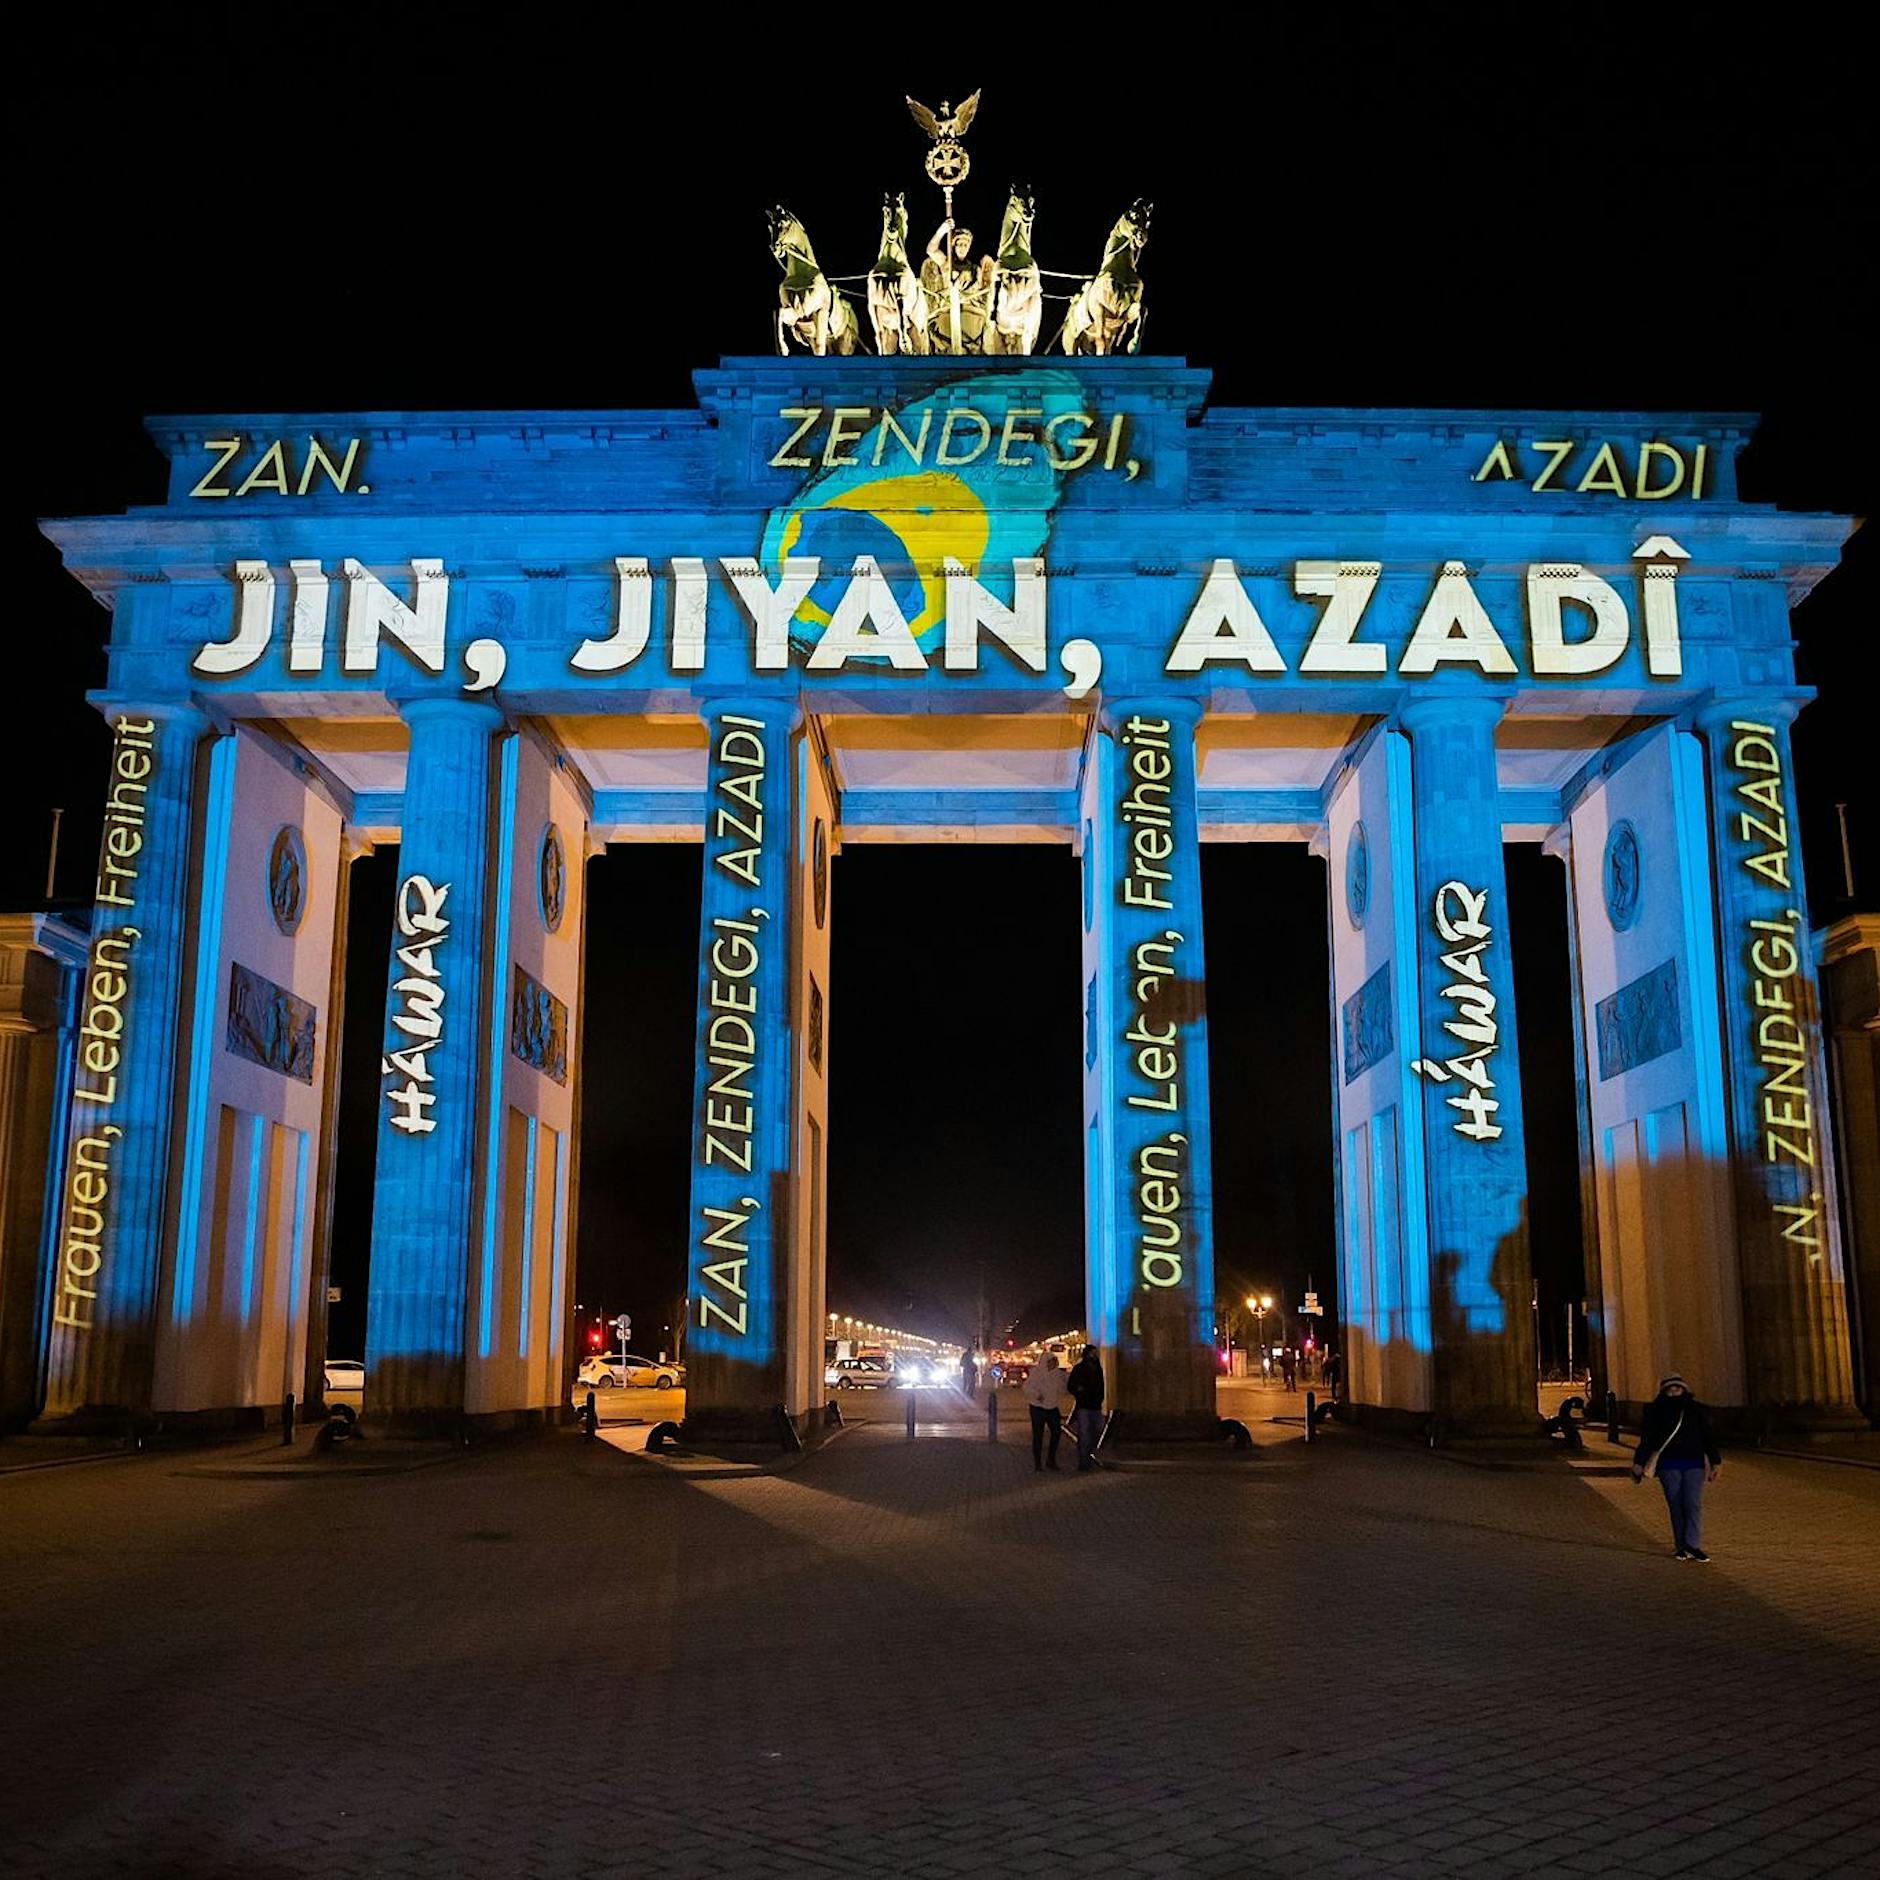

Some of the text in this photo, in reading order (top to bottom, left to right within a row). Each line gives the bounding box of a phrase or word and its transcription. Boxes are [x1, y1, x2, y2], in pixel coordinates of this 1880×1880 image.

[767, 406, 1141, 482] ZENDEGI,
[1470, 440, 1708, 500] AZADI
[193, 535, 1692, 700] JIN, JIYAN, AZADÎ
[1121, 715, 1174, 910] Freiheit
[1731, 720, 1793, 888] AZADI
[54, 715, 155, 1329] Frauen, Leben, Freiheit
[699, 714, 770, 1335] ZAN, ZENDEGI, AZADI
[1132, 1132, 1189, 1336] auen,
